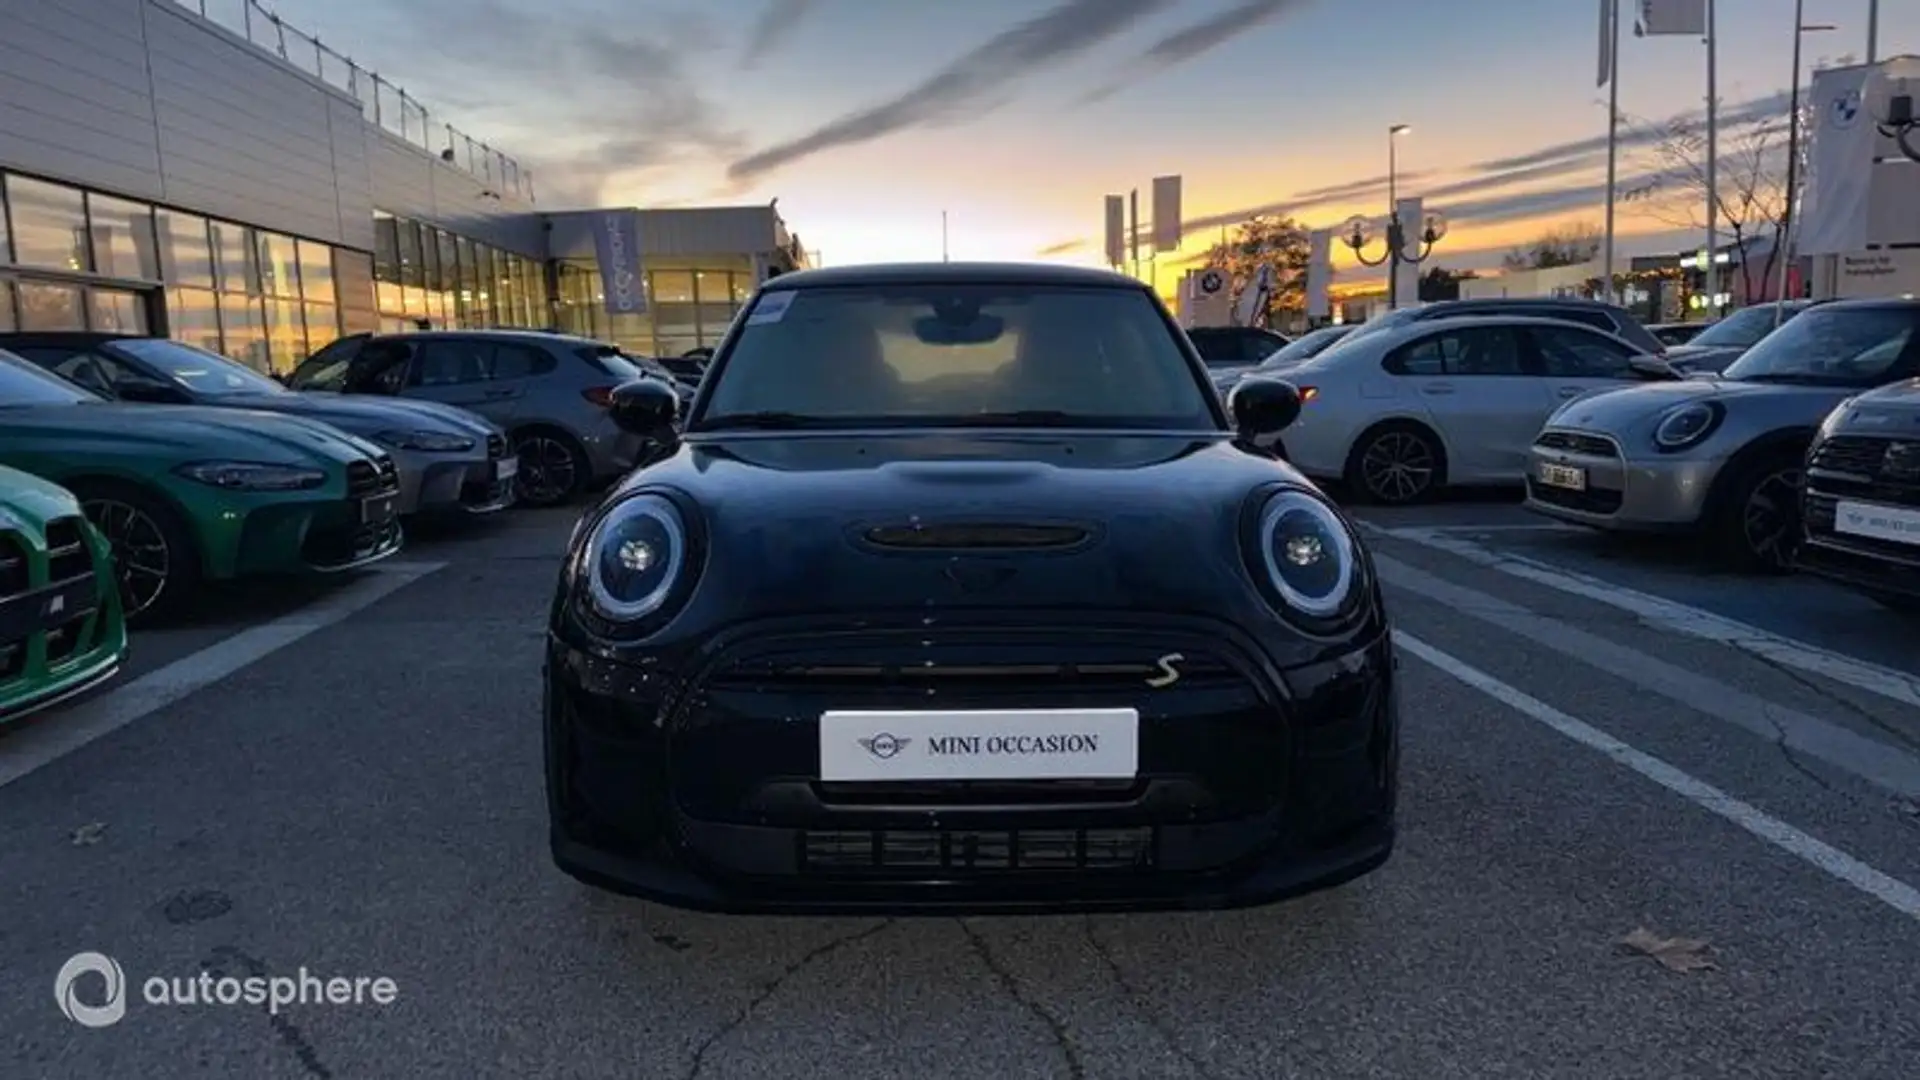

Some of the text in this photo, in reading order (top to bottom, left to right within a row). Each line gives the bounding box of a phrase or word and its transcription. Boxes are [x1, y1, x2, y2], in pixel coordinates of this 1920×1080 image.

[1145, 652, 1184, 687] S
[928, 734, 1099, 755] MINI OCCASION
